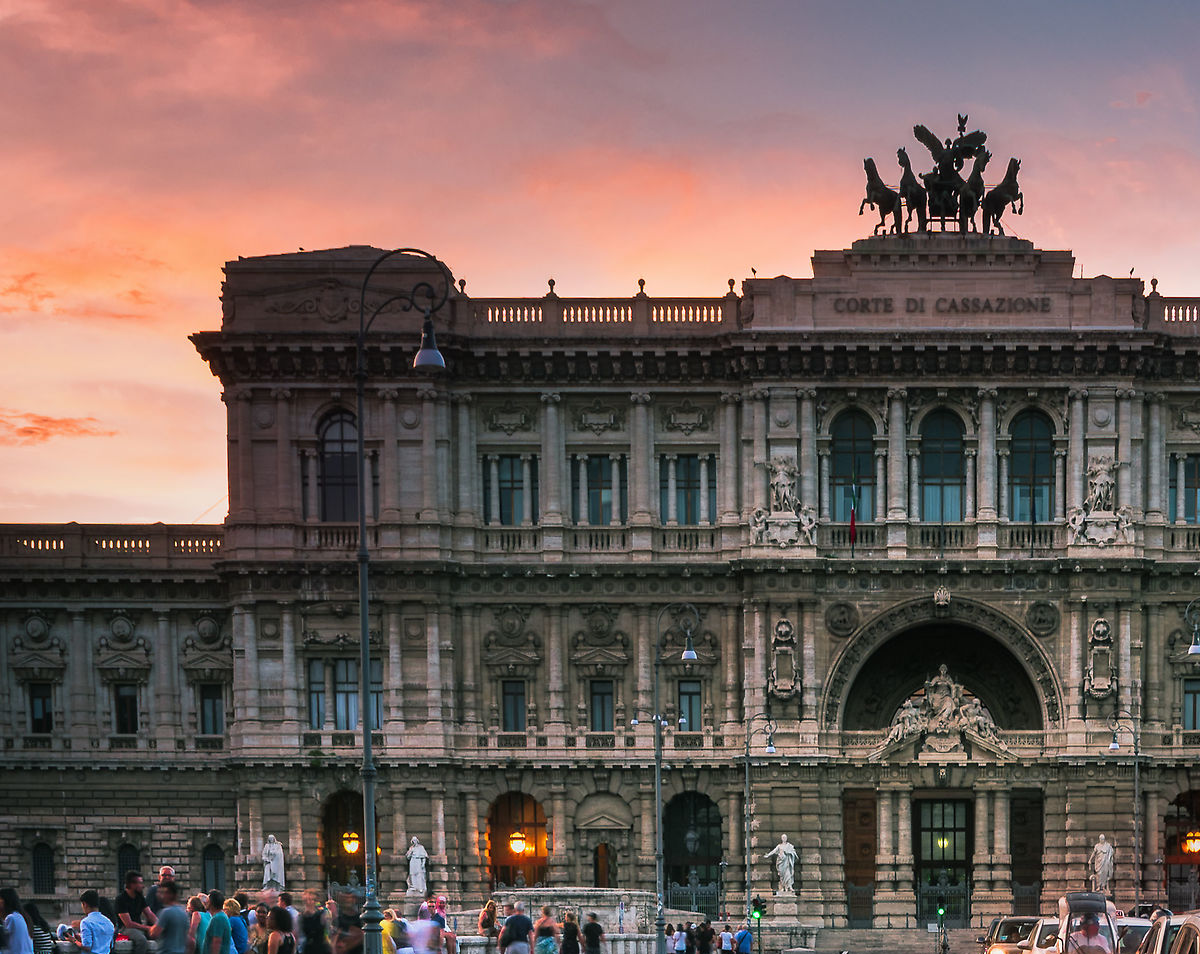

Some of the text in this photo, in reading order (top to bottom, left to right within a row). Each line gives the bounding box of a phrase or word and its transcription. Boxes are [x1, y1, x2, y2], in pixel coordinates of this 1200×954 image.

[834, 297, 1051, 313] CORTE DI CASSAZIONE
